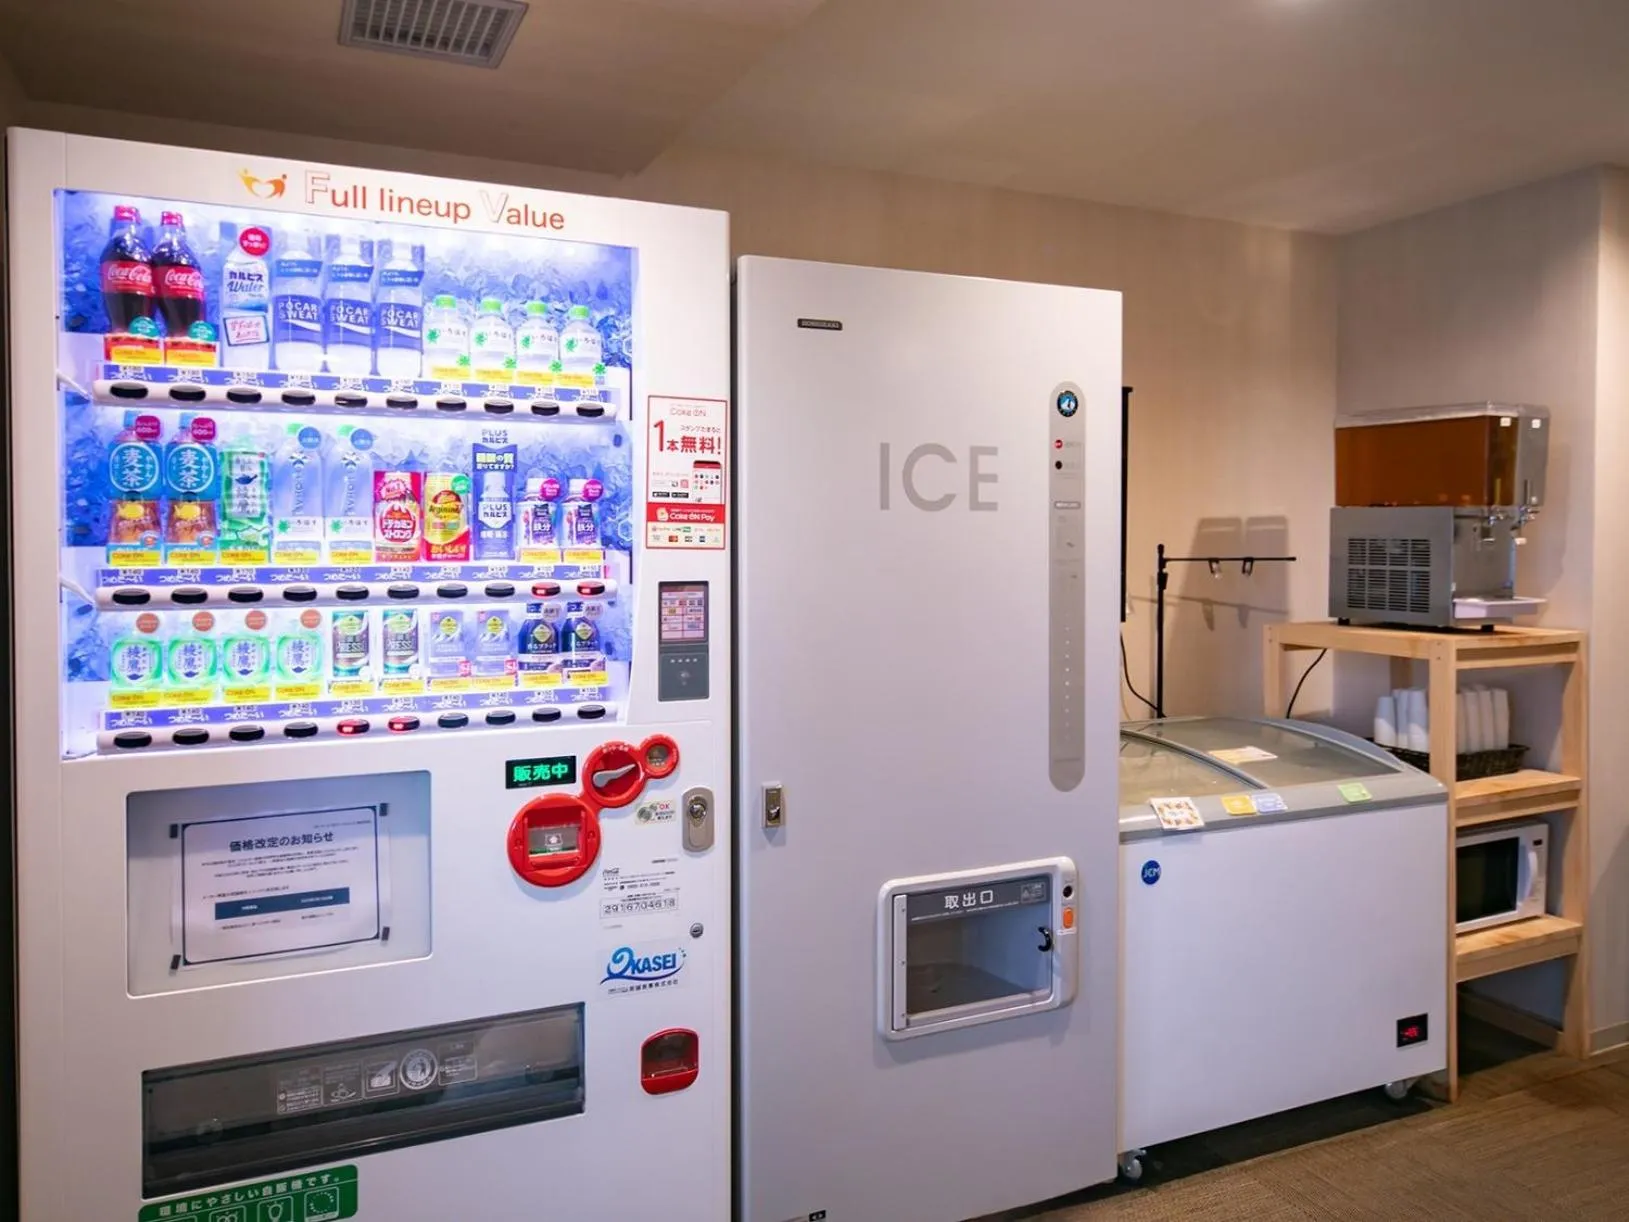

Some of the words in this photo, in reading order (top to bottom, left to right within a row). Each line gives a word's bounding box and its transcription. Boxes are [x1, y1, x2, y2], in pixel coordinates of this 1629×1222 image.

[305, 170, 367, 210] Full
[380, 189, 471, 225] lineup
[479, 188, 565, 230] Value
[107, 263, 152, 284] Coca-Cola
[121, 448, 144, 487] 麦茶
[179, 449, 200, 488] 麦茶
[879, 442, 999, 512] ICE
[513, 762, 569, 782] 販売中
[229, 831, 334, 852] 価格改定のお知らせ
[943, 889, 994, 910] 取出口
